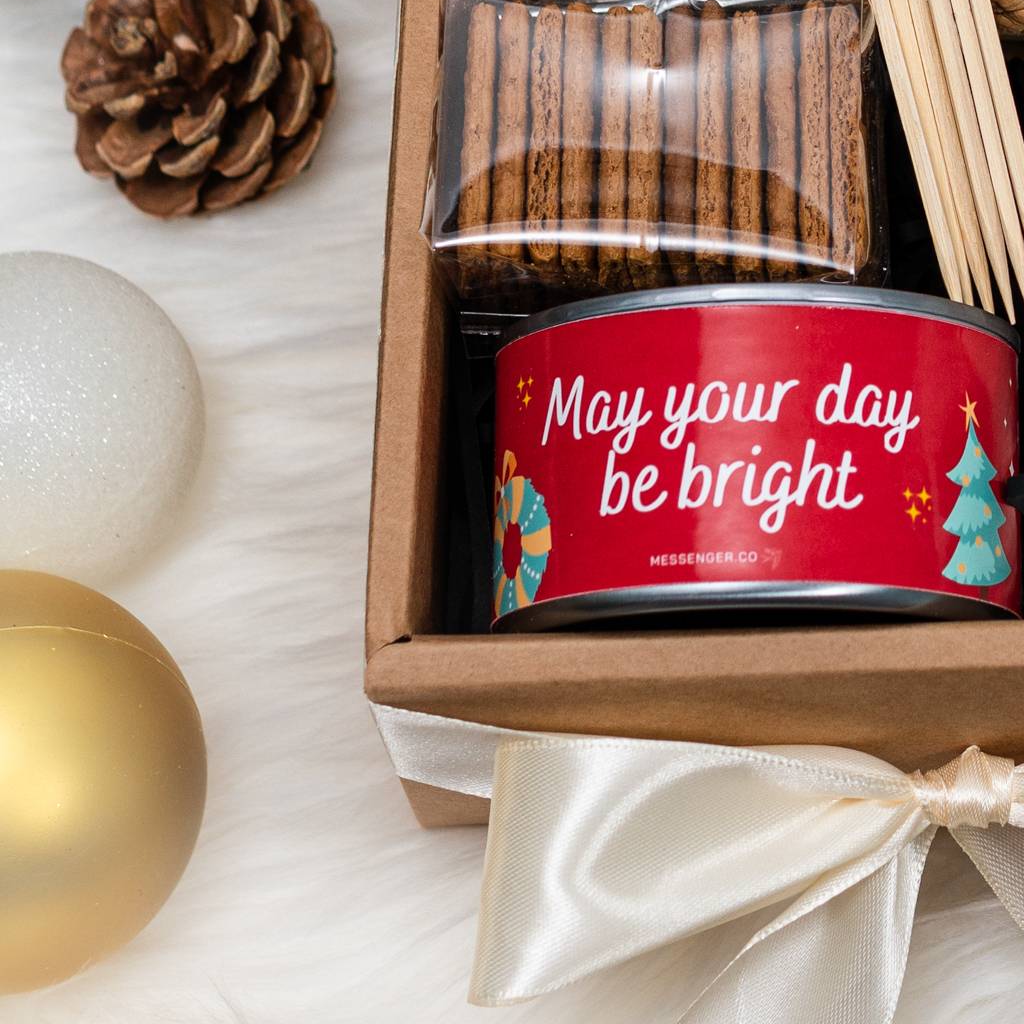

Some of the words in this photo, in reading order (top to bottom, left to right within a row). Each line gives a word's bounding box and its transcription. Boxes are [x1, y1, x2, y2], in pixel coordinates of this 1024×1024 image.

[542, 374, 652, 456] May
[660, 379, 799, 450] your
[815, 363, 920, 453] day
[600, 450, 667, 517] be
[677, 439, 863, 534] bright
[649, 552, 758, 568] MESSENGER.CO
